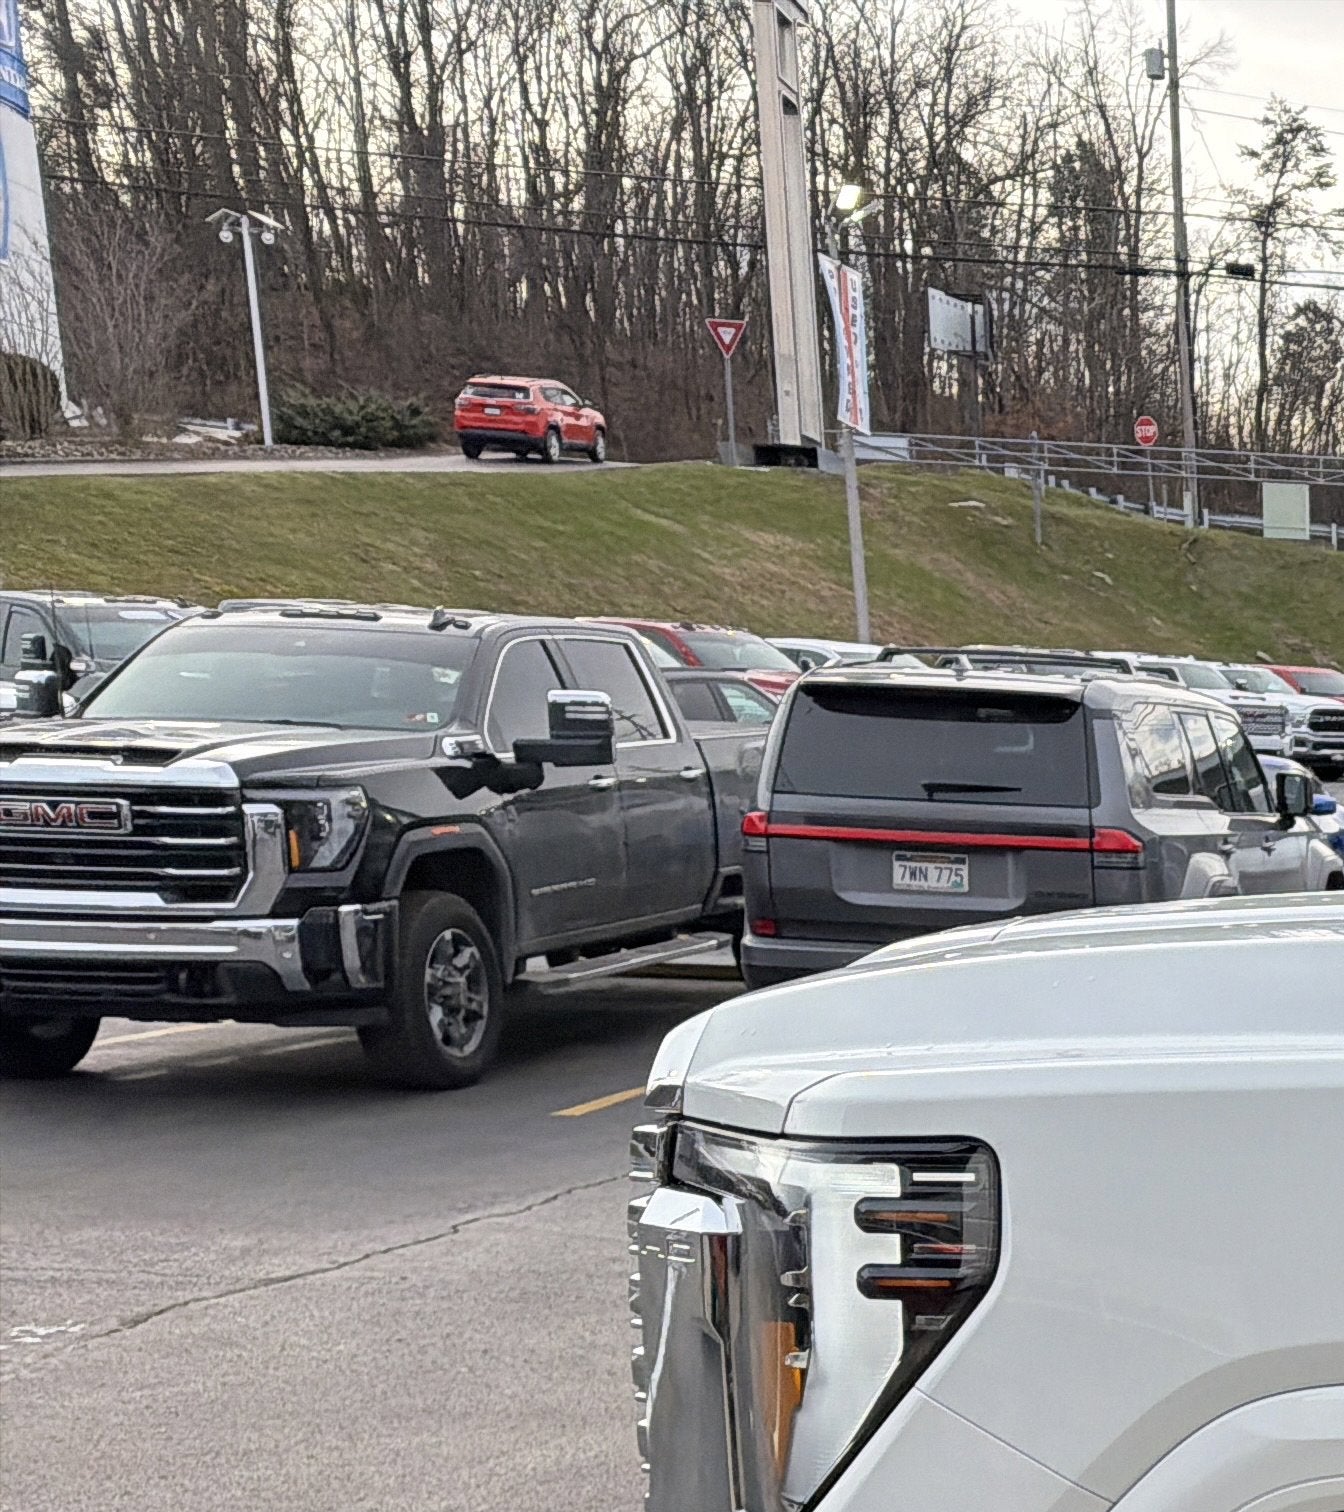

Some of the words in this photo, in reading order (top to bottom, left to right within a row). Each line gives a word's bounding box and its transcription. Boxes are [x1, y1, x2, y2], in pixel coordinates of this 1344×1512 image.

[1136, 425, 1155, 437] STOP
[0, 802, 120, 827] GMC
[899, 864, 928, 882] 7WN
[934, 865, 964, 885] 775
